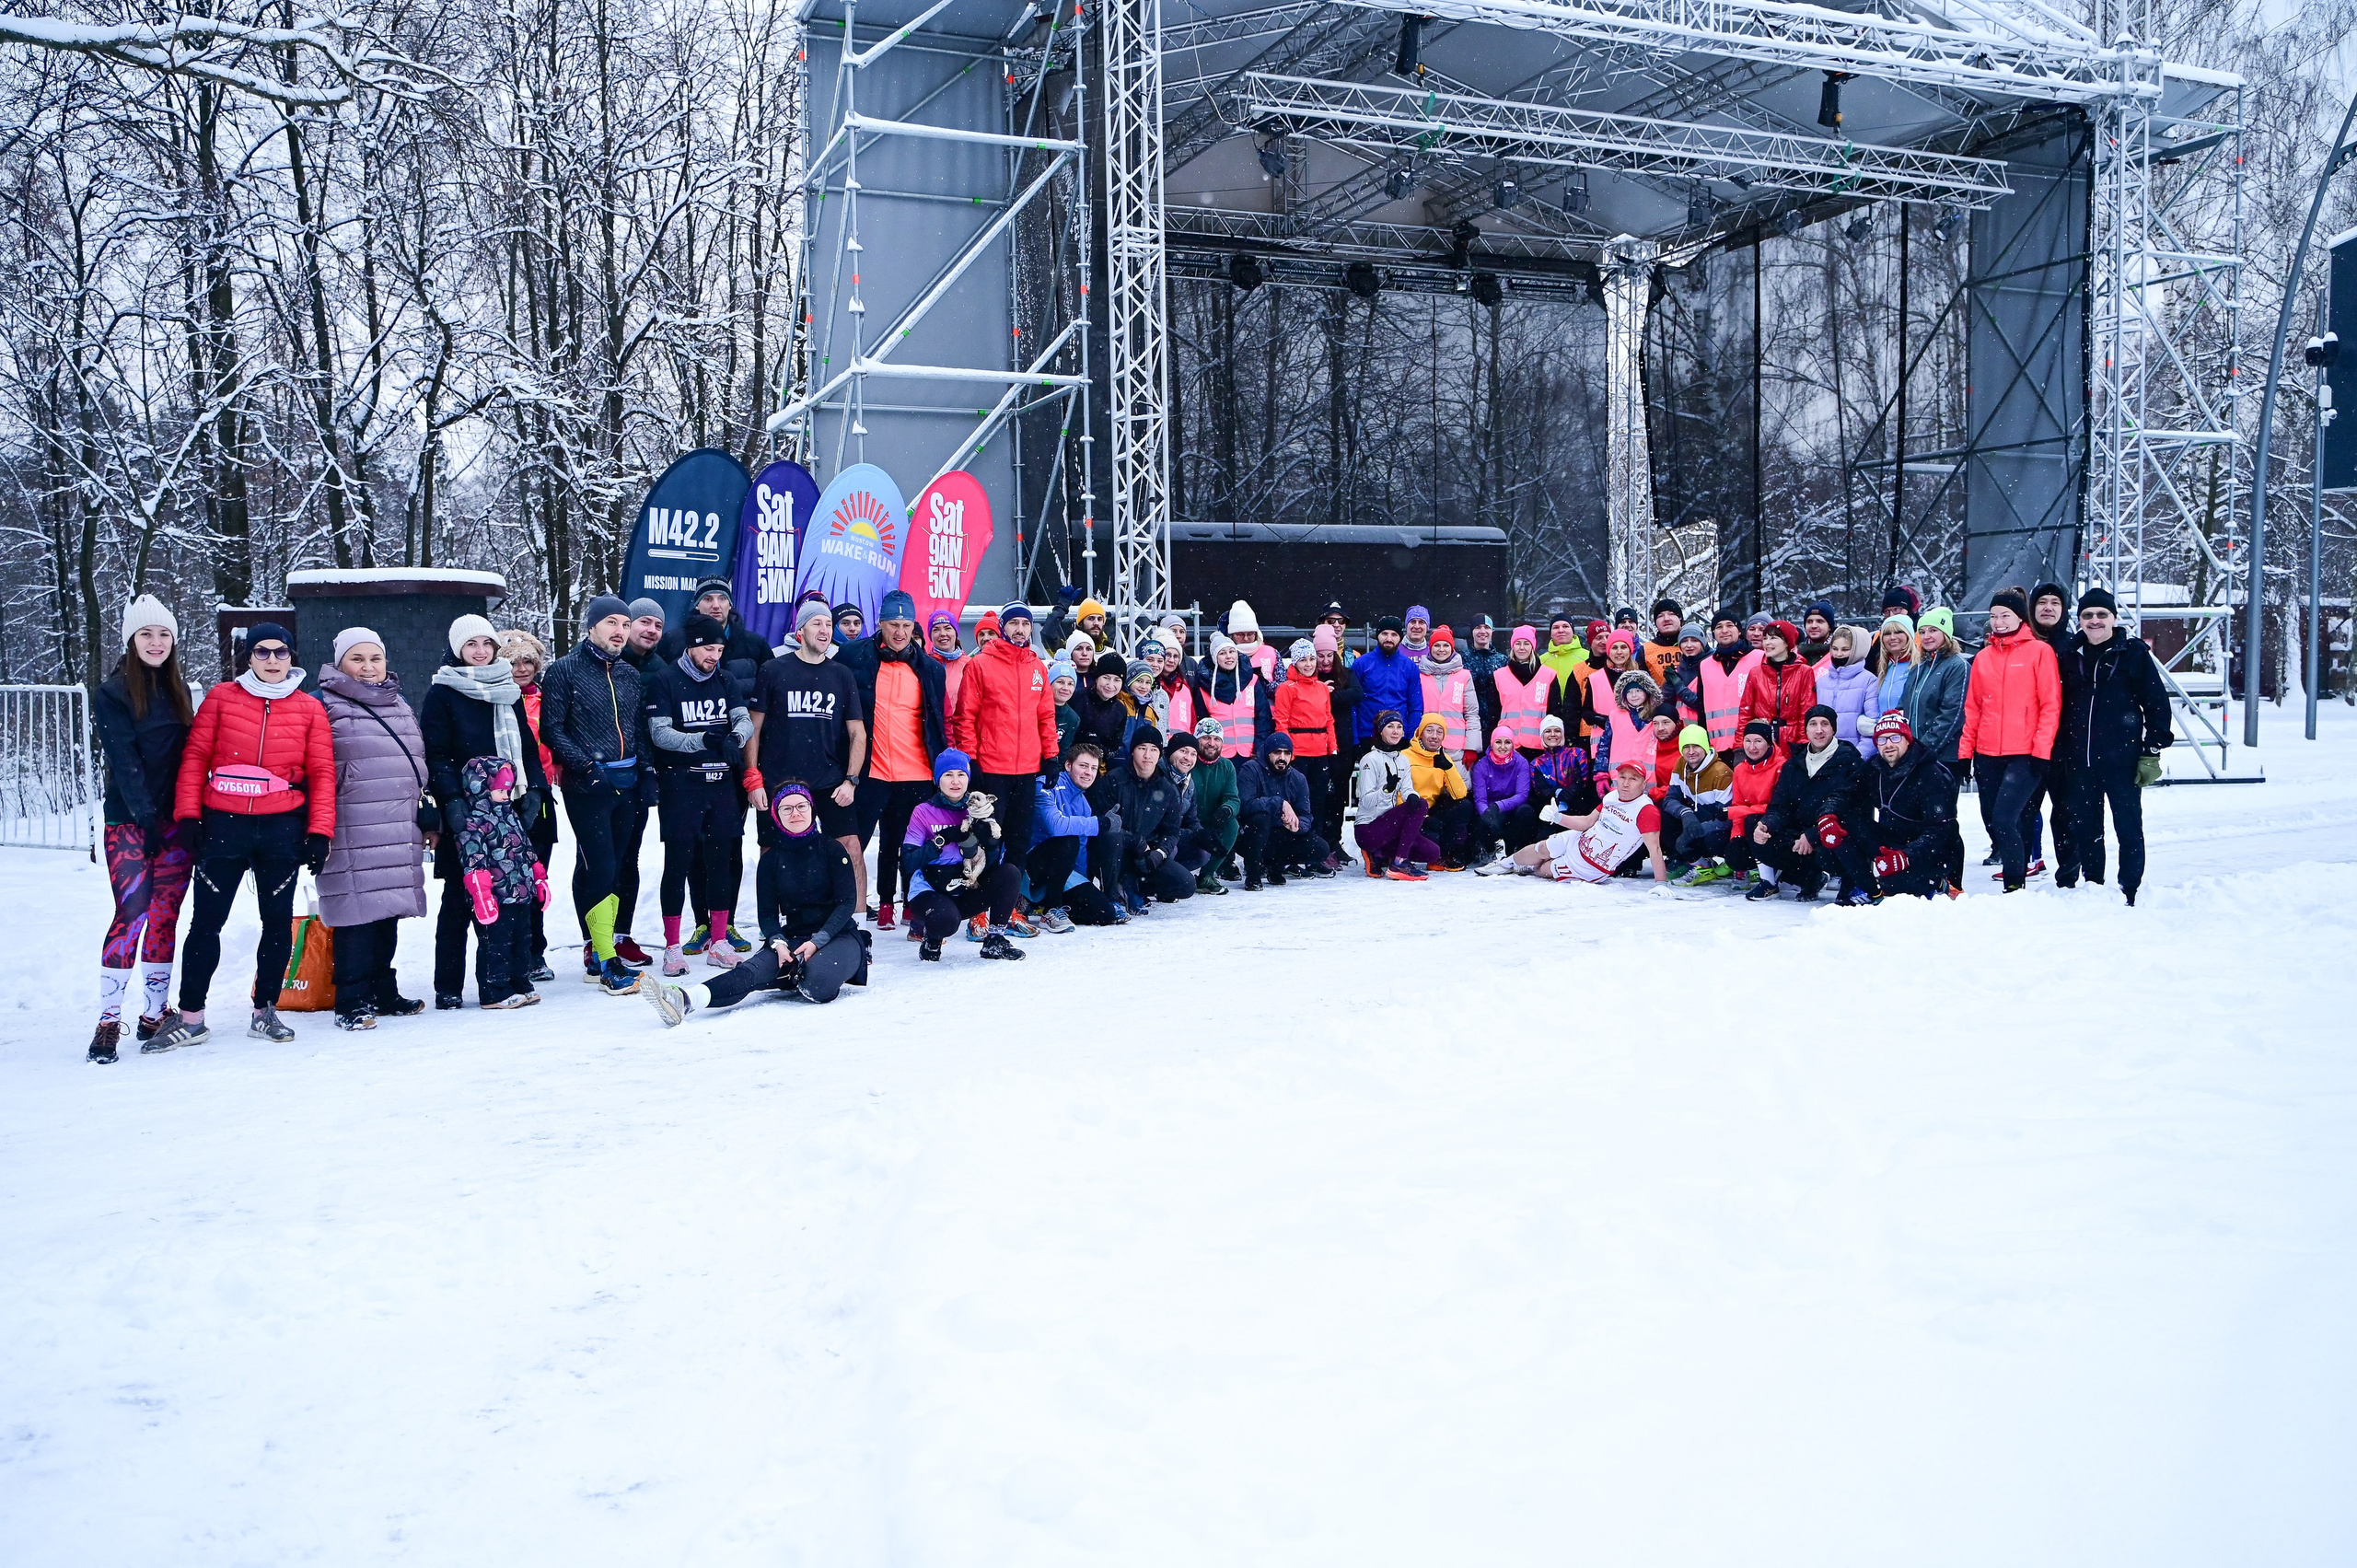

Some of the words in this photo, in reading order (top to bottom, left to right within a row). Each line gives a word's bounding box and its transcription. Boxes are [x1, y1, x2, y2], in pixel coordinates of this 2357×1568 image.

[756, 483, 795, 533] Sat
[929, 492, 965, 536] Sat
[648, 506, 720, 550] M42.2
[757, 531, 795, 568] 9AM
[850, 535, 875, 548] MOSCOW
[928, 533, 963, 568] 9AM
[644, 575, 679, 591] MISSION
[757, 568, 795, 605] 5KM
[928, 565, 961, 600] 5KM
[1657, 652, 1682, 665] 30:0
[681, 698, 727, 723] M42.2
[787, 691, 836, 714] M42.2
[1875, 721, 1900, 733] CANADA
[217, 780, 262, 795] СУББОТА
[705, 772, 724, 781] M42.2
